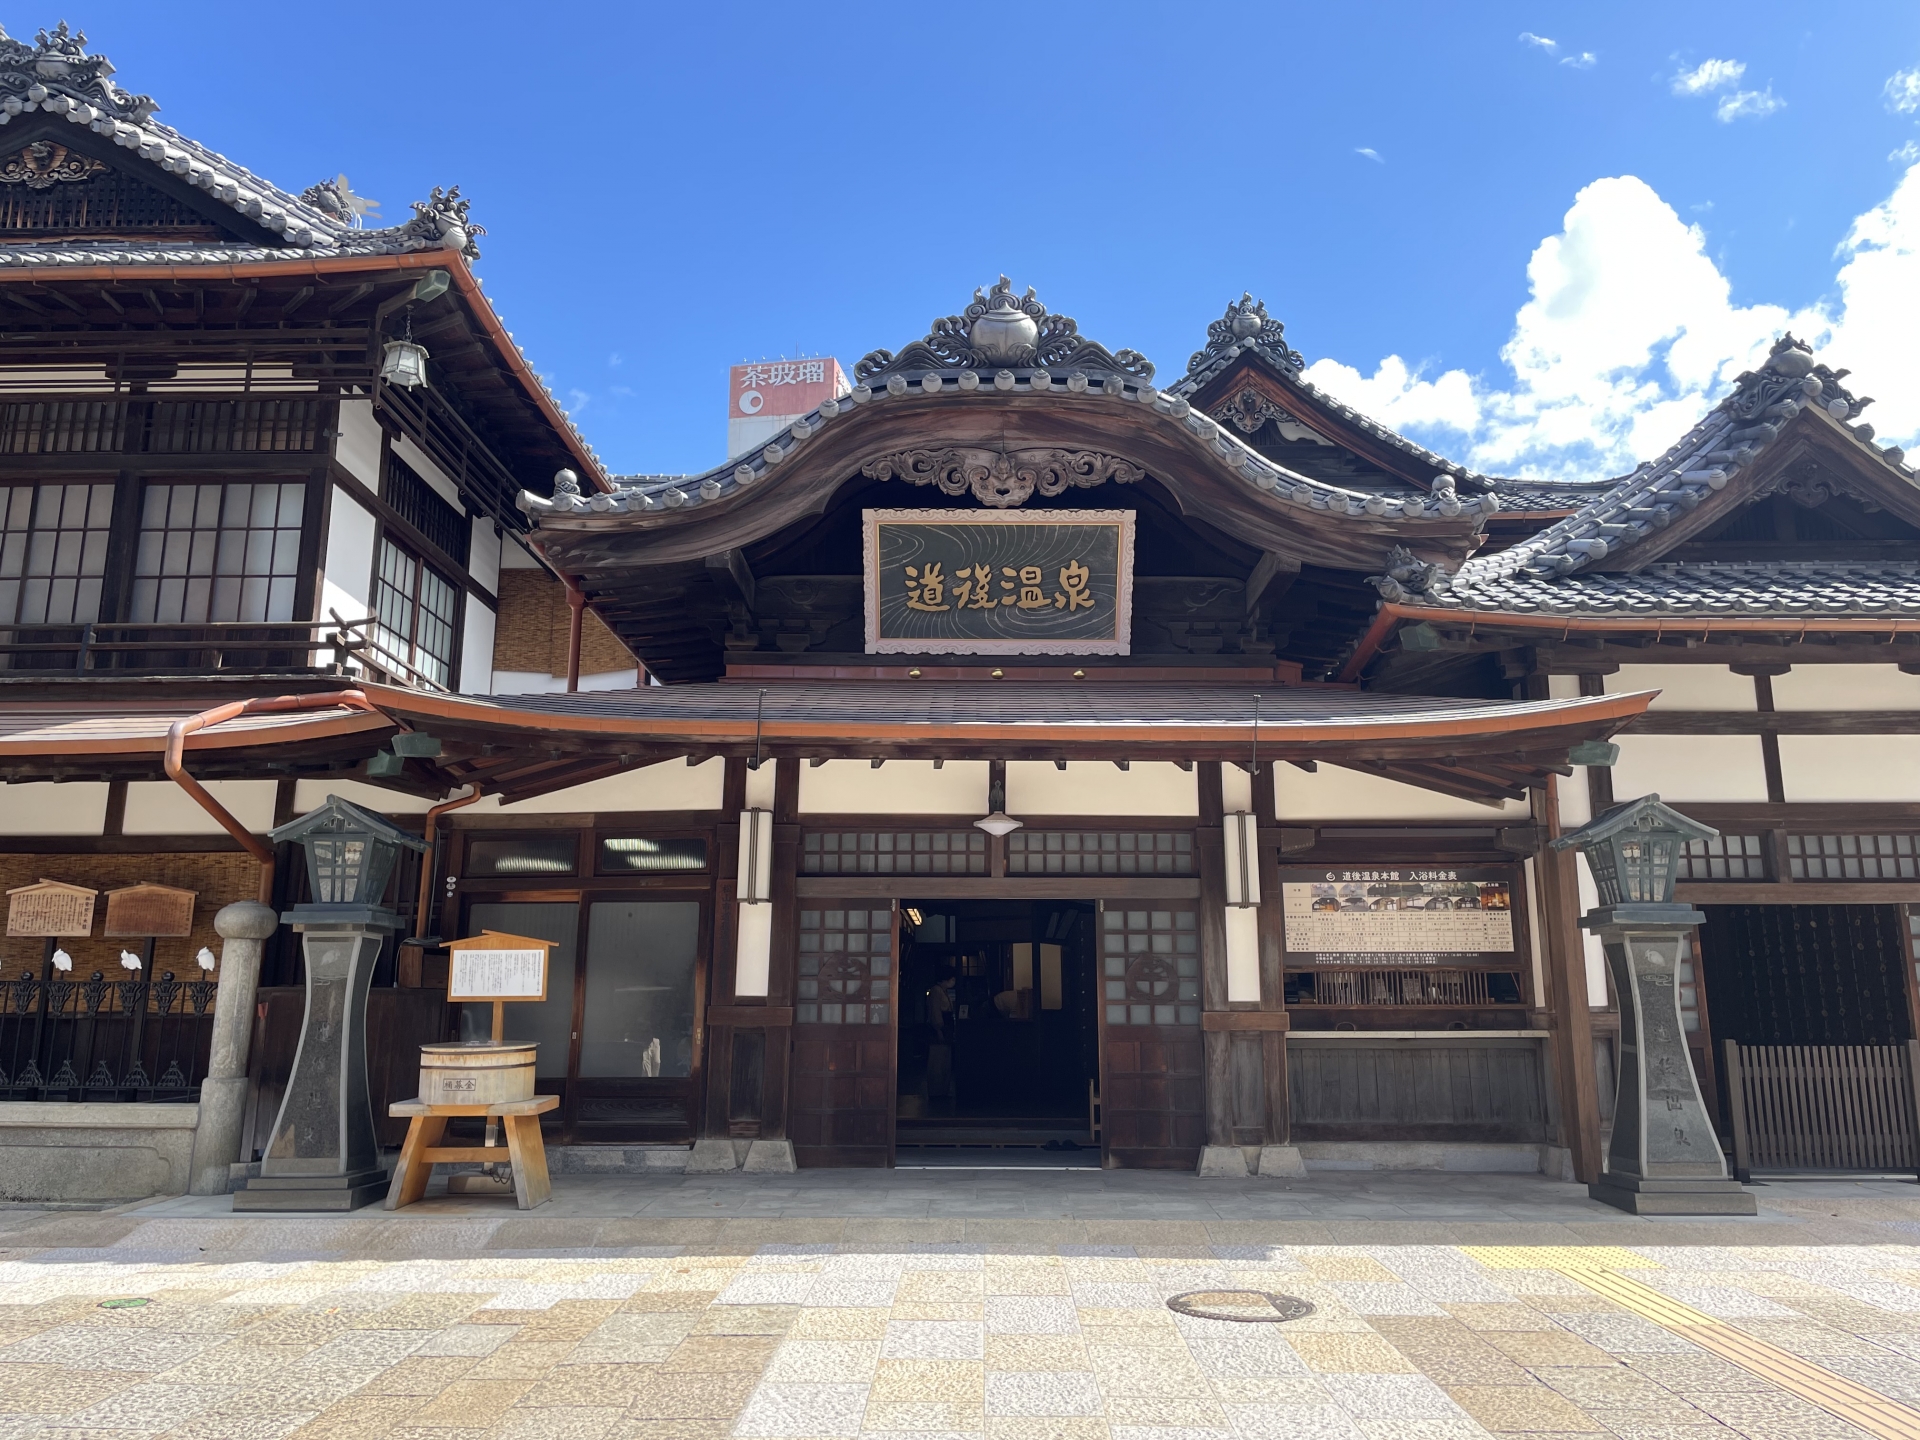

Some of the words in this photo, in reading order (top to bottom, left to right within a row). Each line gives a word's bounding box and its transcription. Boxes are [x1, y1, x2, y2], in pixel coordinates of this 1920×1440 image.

[739, 361, 825, 389] 茶玻瑠
[1342, 871, 1400, 881] 道後温泉本館
[1409, 871, 1458, 881] 入浴料金表
